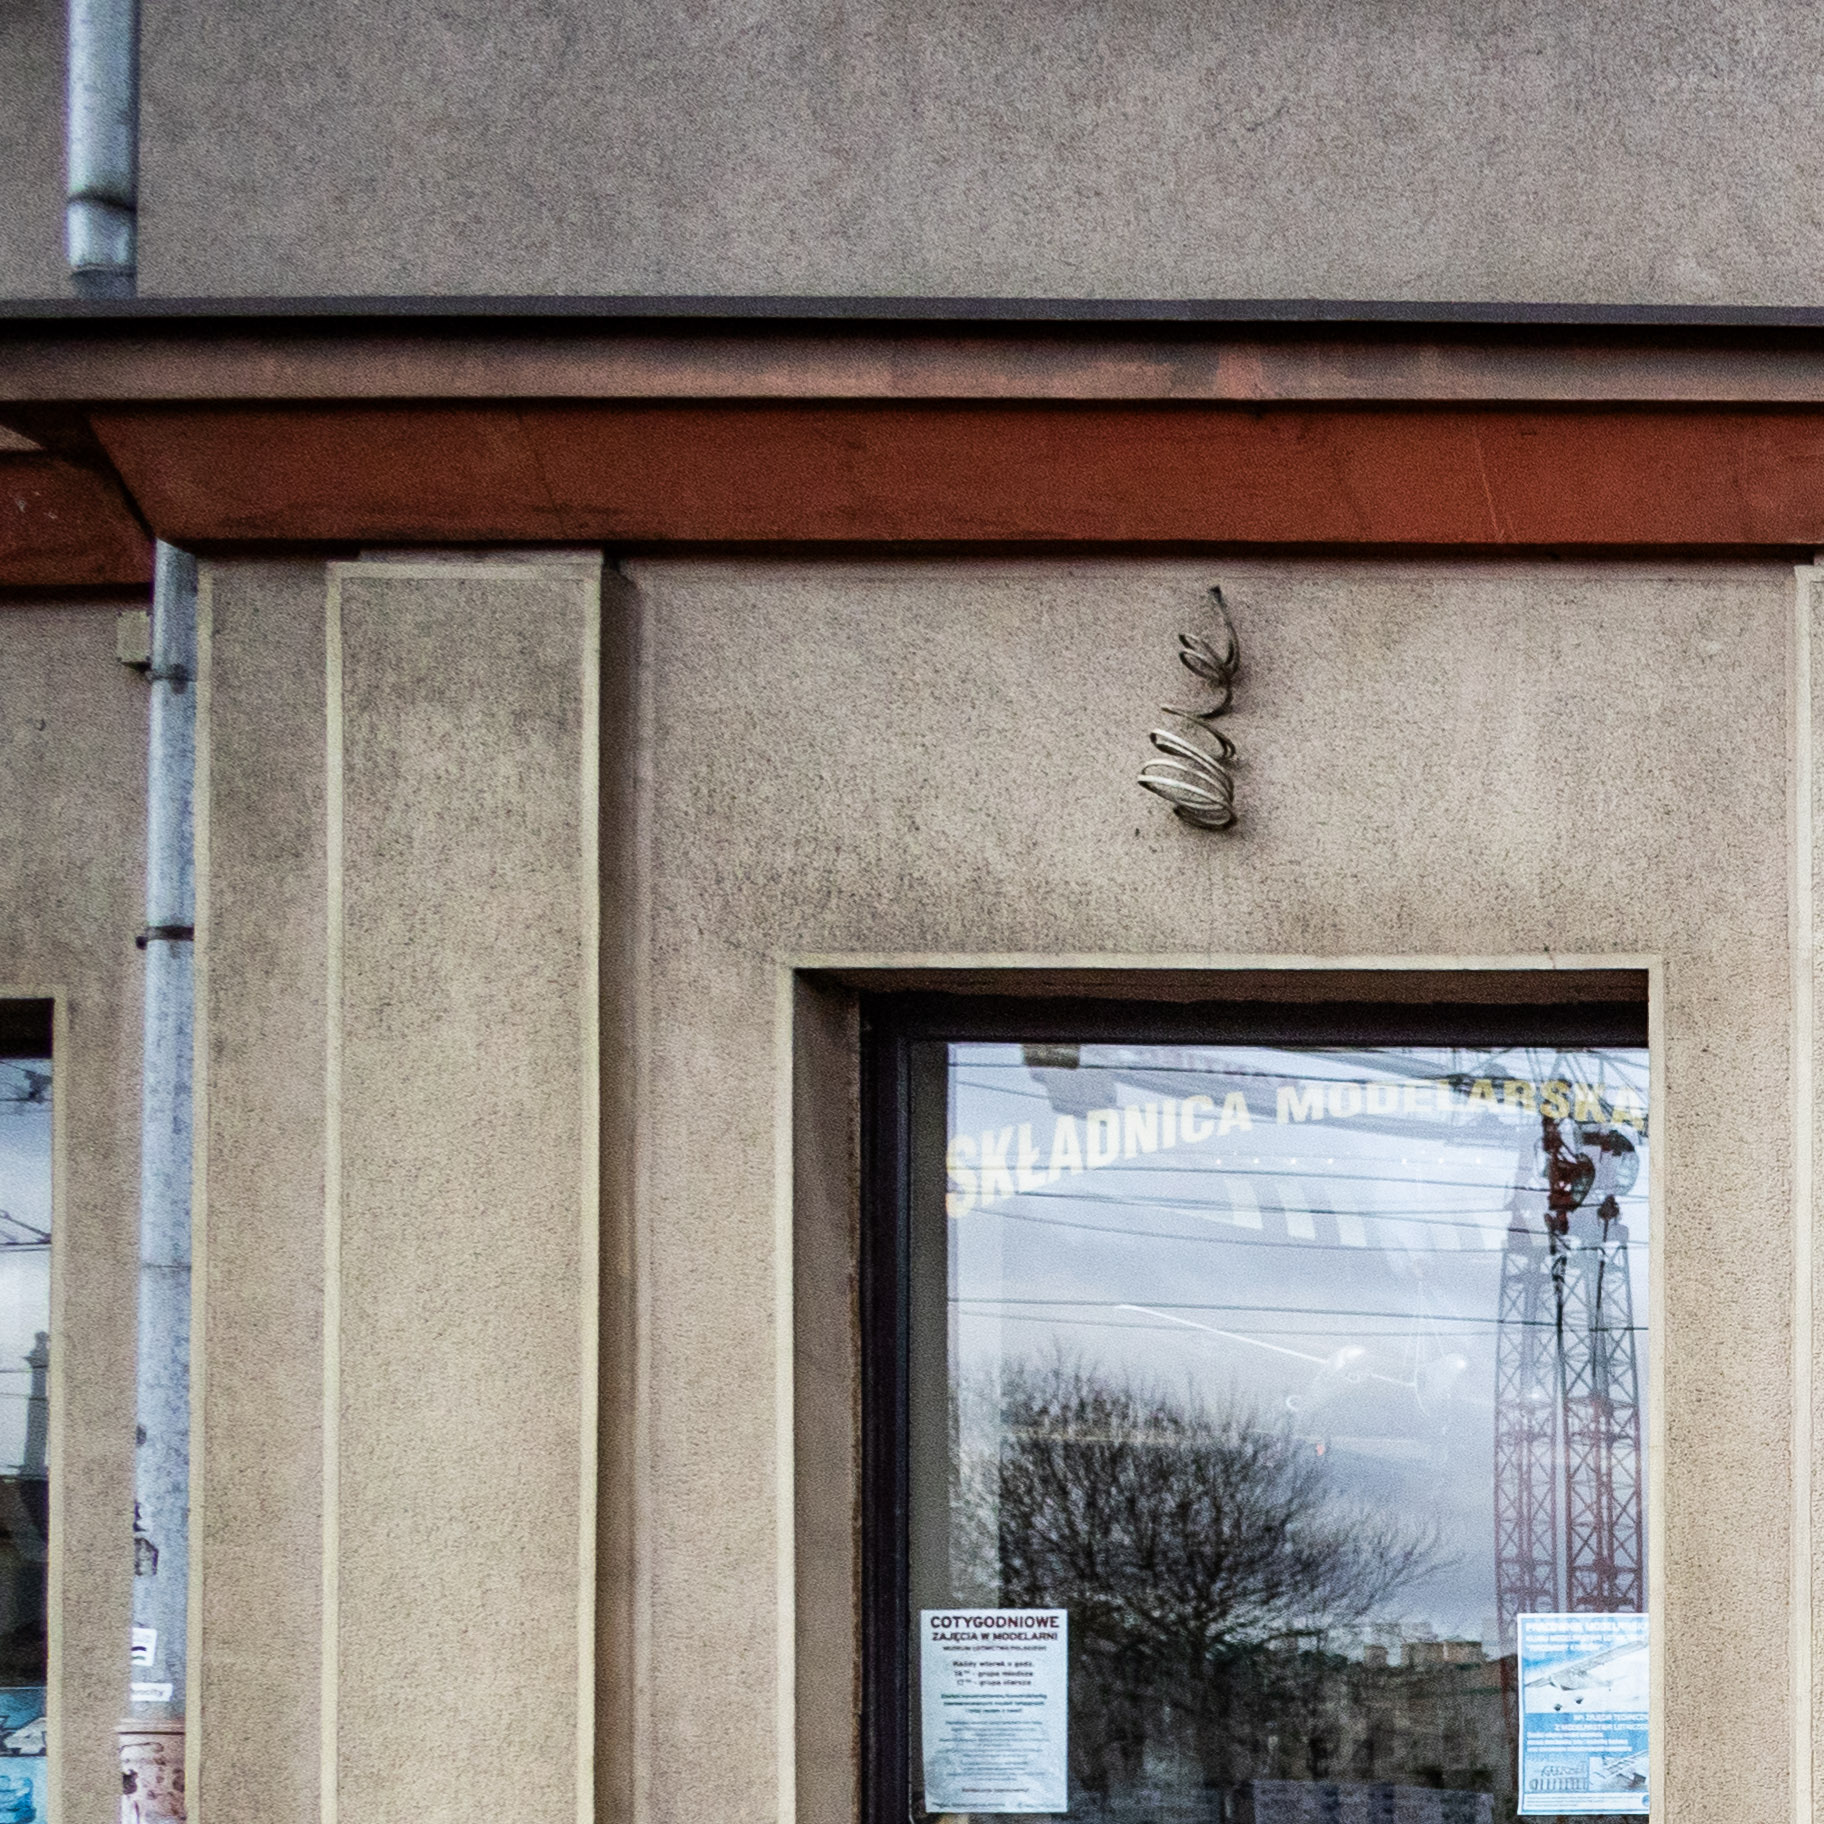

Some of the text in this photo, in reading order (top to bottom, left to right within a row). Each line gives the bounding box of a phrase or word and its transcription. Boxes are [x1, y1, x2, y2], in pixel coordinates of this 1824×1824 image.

[946, 1078, 1648, 1219] SKŁADNICA MODELARSKA
[930, 1616, 1060, 1629] COTYGODNIOWE
[931, 1632, 1058, 1643] ZAJĘCIA W MODELARNI
